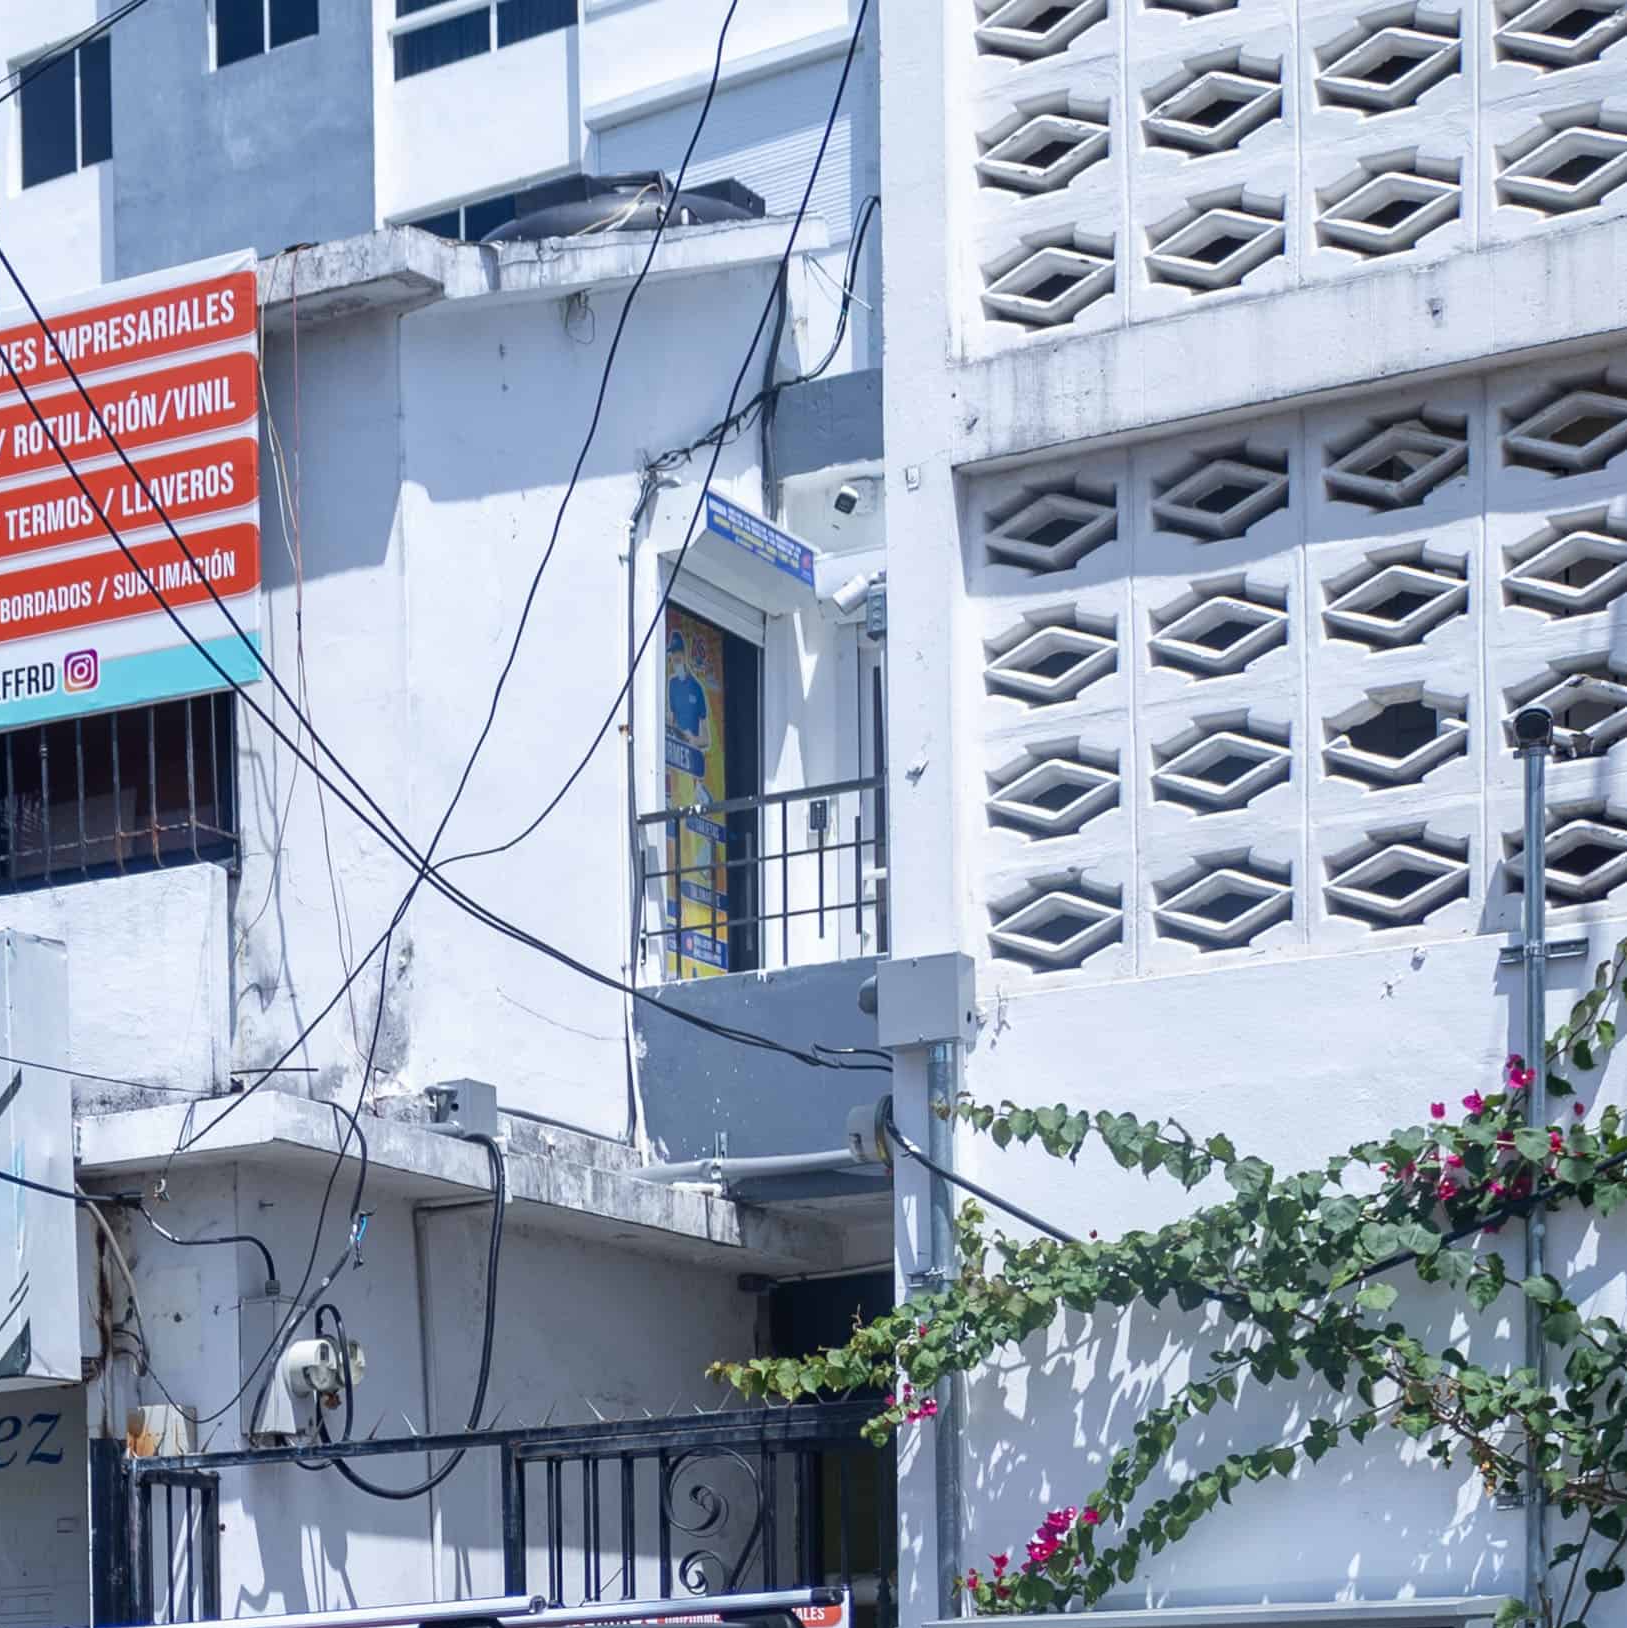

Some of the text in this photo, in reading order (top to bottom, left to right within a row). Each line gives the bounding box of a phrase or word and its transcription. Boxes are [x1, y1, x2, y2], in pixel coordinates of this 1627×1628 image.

[45, 290, 235, 366] EMPRESARIALES
[5, 494, 94, 542] TERMOS
[121, 462, 235, 516] LLAVEROS
[0, 581, 92, 624] BORDADOS
[113, 548, 236, 601] SUBLIMACIÓN
